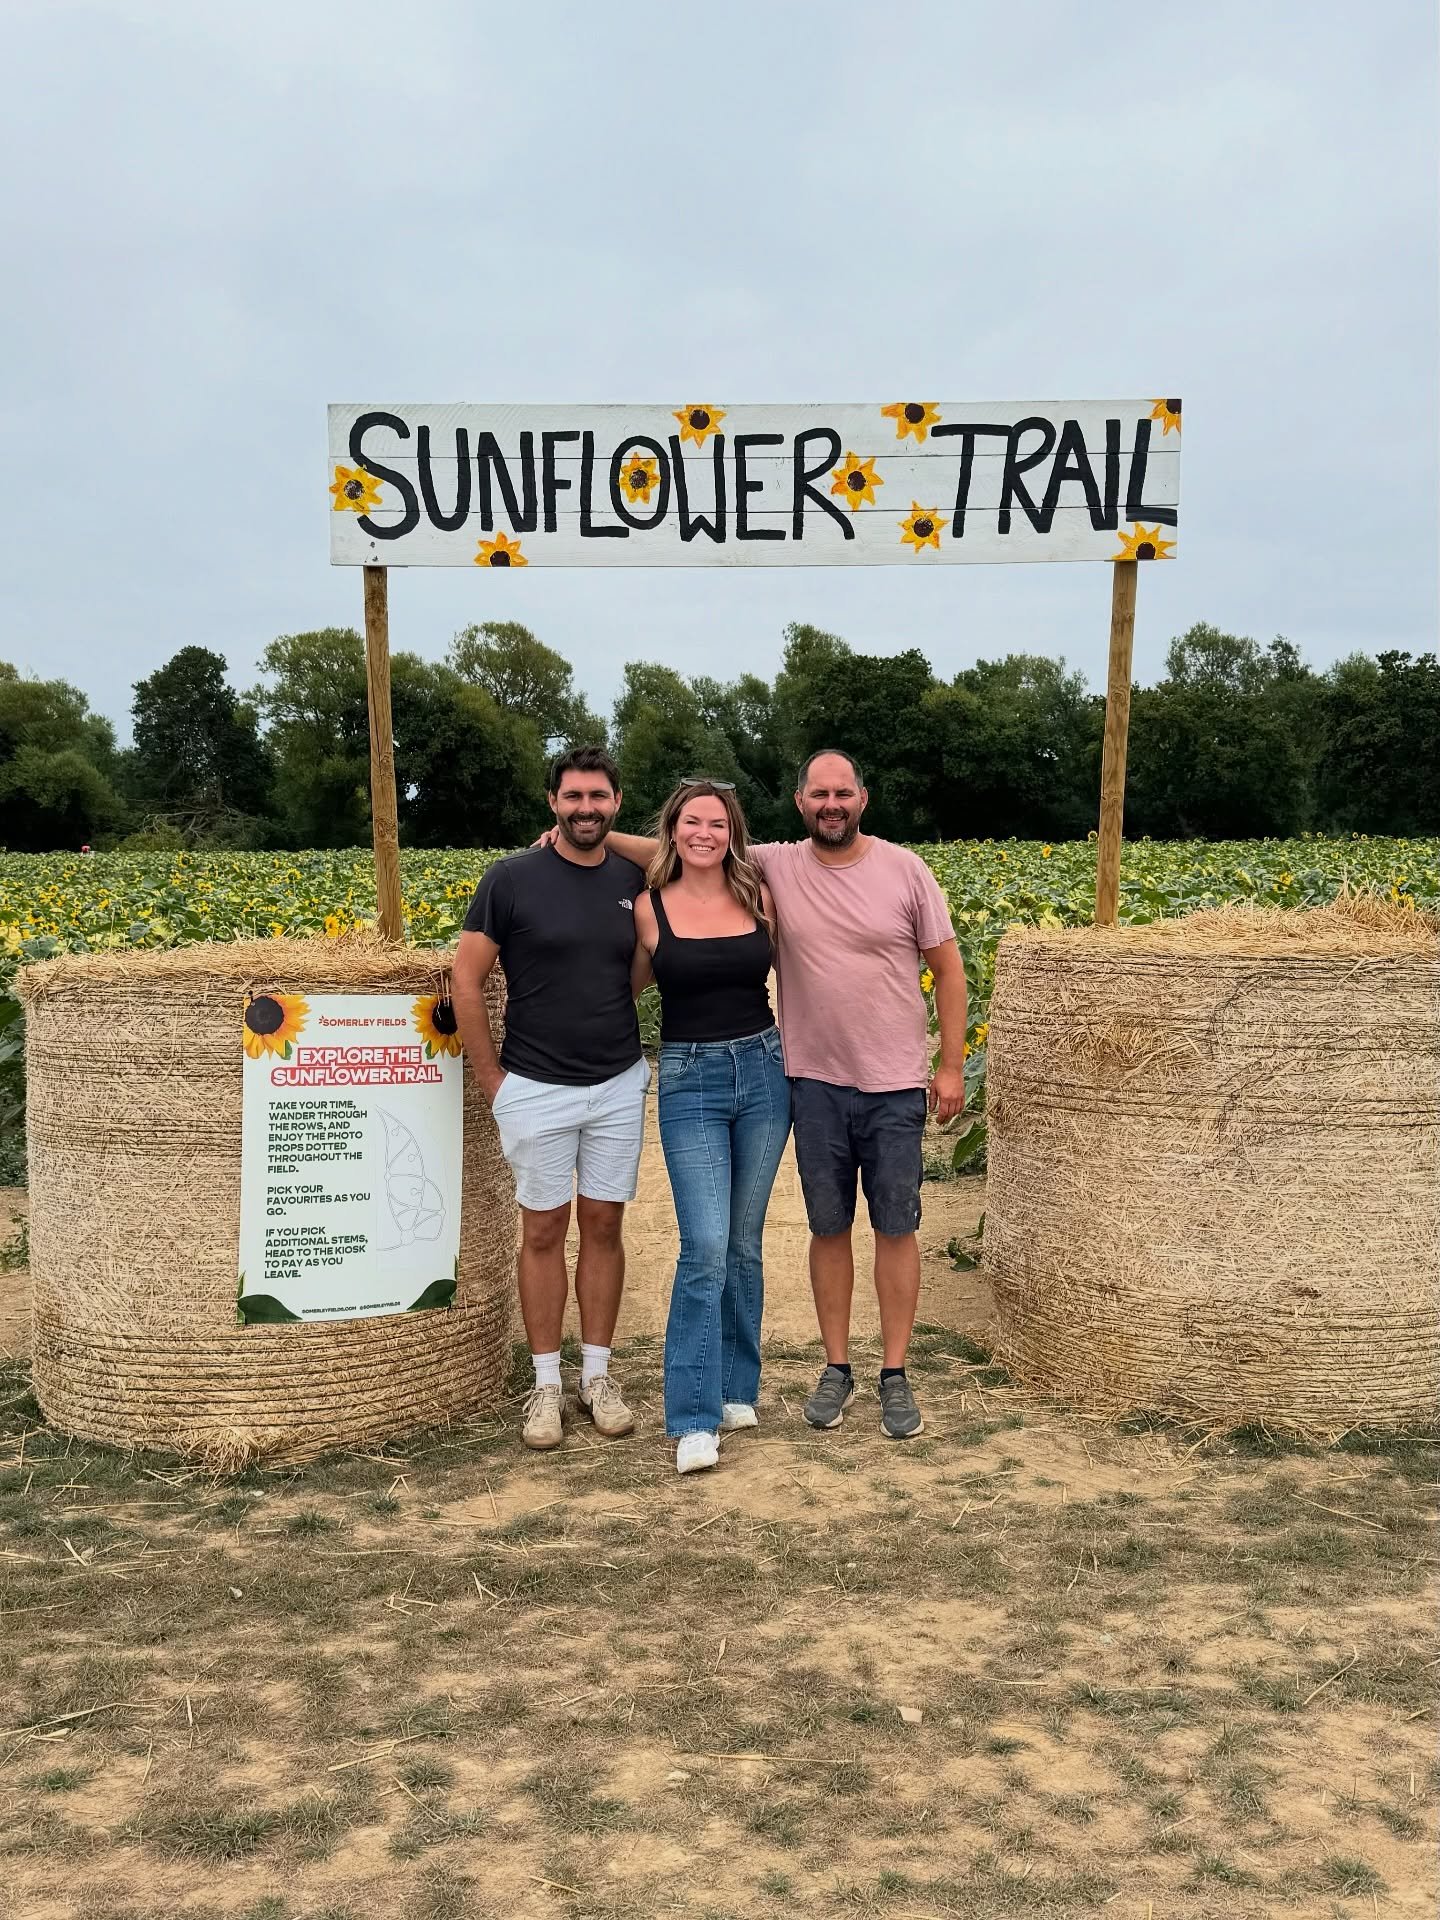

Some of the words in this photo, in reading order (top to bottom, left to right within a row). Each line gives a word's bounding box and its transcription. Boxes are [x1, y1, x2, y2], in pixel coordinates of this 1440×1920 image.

[349, 411, 855, 541] SUNFLOWER
[931, 416, 1178, 539] TRAIL
[323, 1018, 375, 1026] SOMERLEY
[377, 1018, 406, 1026] FIELDS
[300, 1050, 385, 1065] EXPLORE
[388, 1049, 420, 1063] THE
[273, 1067, 392, 1084] SUNFLOWER
[395, 1068, 440, 1082] TRAIL
[269, 1102, 297, 1110] TAKE
[330, 1101, 356, 1109] TIME,
[269, 1112, 315, 1120] WANDER
[318, 1111, 367, 1119] THROUGH
[291, 1122, 326, 1131] ROWS,
[328, 1121, 350, 1129] AND
[269, 1133, 303, 1141] ENJOY
[306, 1132, 326, 1140] THE
[328, 1131, 363, 1139] PHOTO
[268, 1144, 304, 1152] PROPS
[306, 1143, 347, 1151] DOTTED
[268, 1154, 341, 1162] THROUGHOUT
[268, 1165, 299, 1173] FIELD.
[267, 1186, 292, 1194] PICK
[295, 1185, 323, 1193] YOUR
[267, 1195, 332, 1205] FAVOURITES
[334, 1194, 348, 1202] AS
[350, 1193, 370, 1201] YOU
[267, 1208, 286, 1216] GO.
[277, 1228, 298, 1236] YOU
[301, 1227, 325, 1235] PICK
[266, 1237, 329, 1246] ADDITIONAL
[331, 1235, 368, 1244] STEMS,
[265, 1249, 294, 1257] HEAD
[296, 1248, 311, 1256] TO
[313, 1247, 333, 1255] THE
[335, 1245, 365, 1254] KIOSK
[265, 1260, 280, 1268] TO
[282, 1259, 302, 1267] PAY
[321, 1257, 343, 1265] YOU
[265, 1270, 301, 1279] LEAVE.
